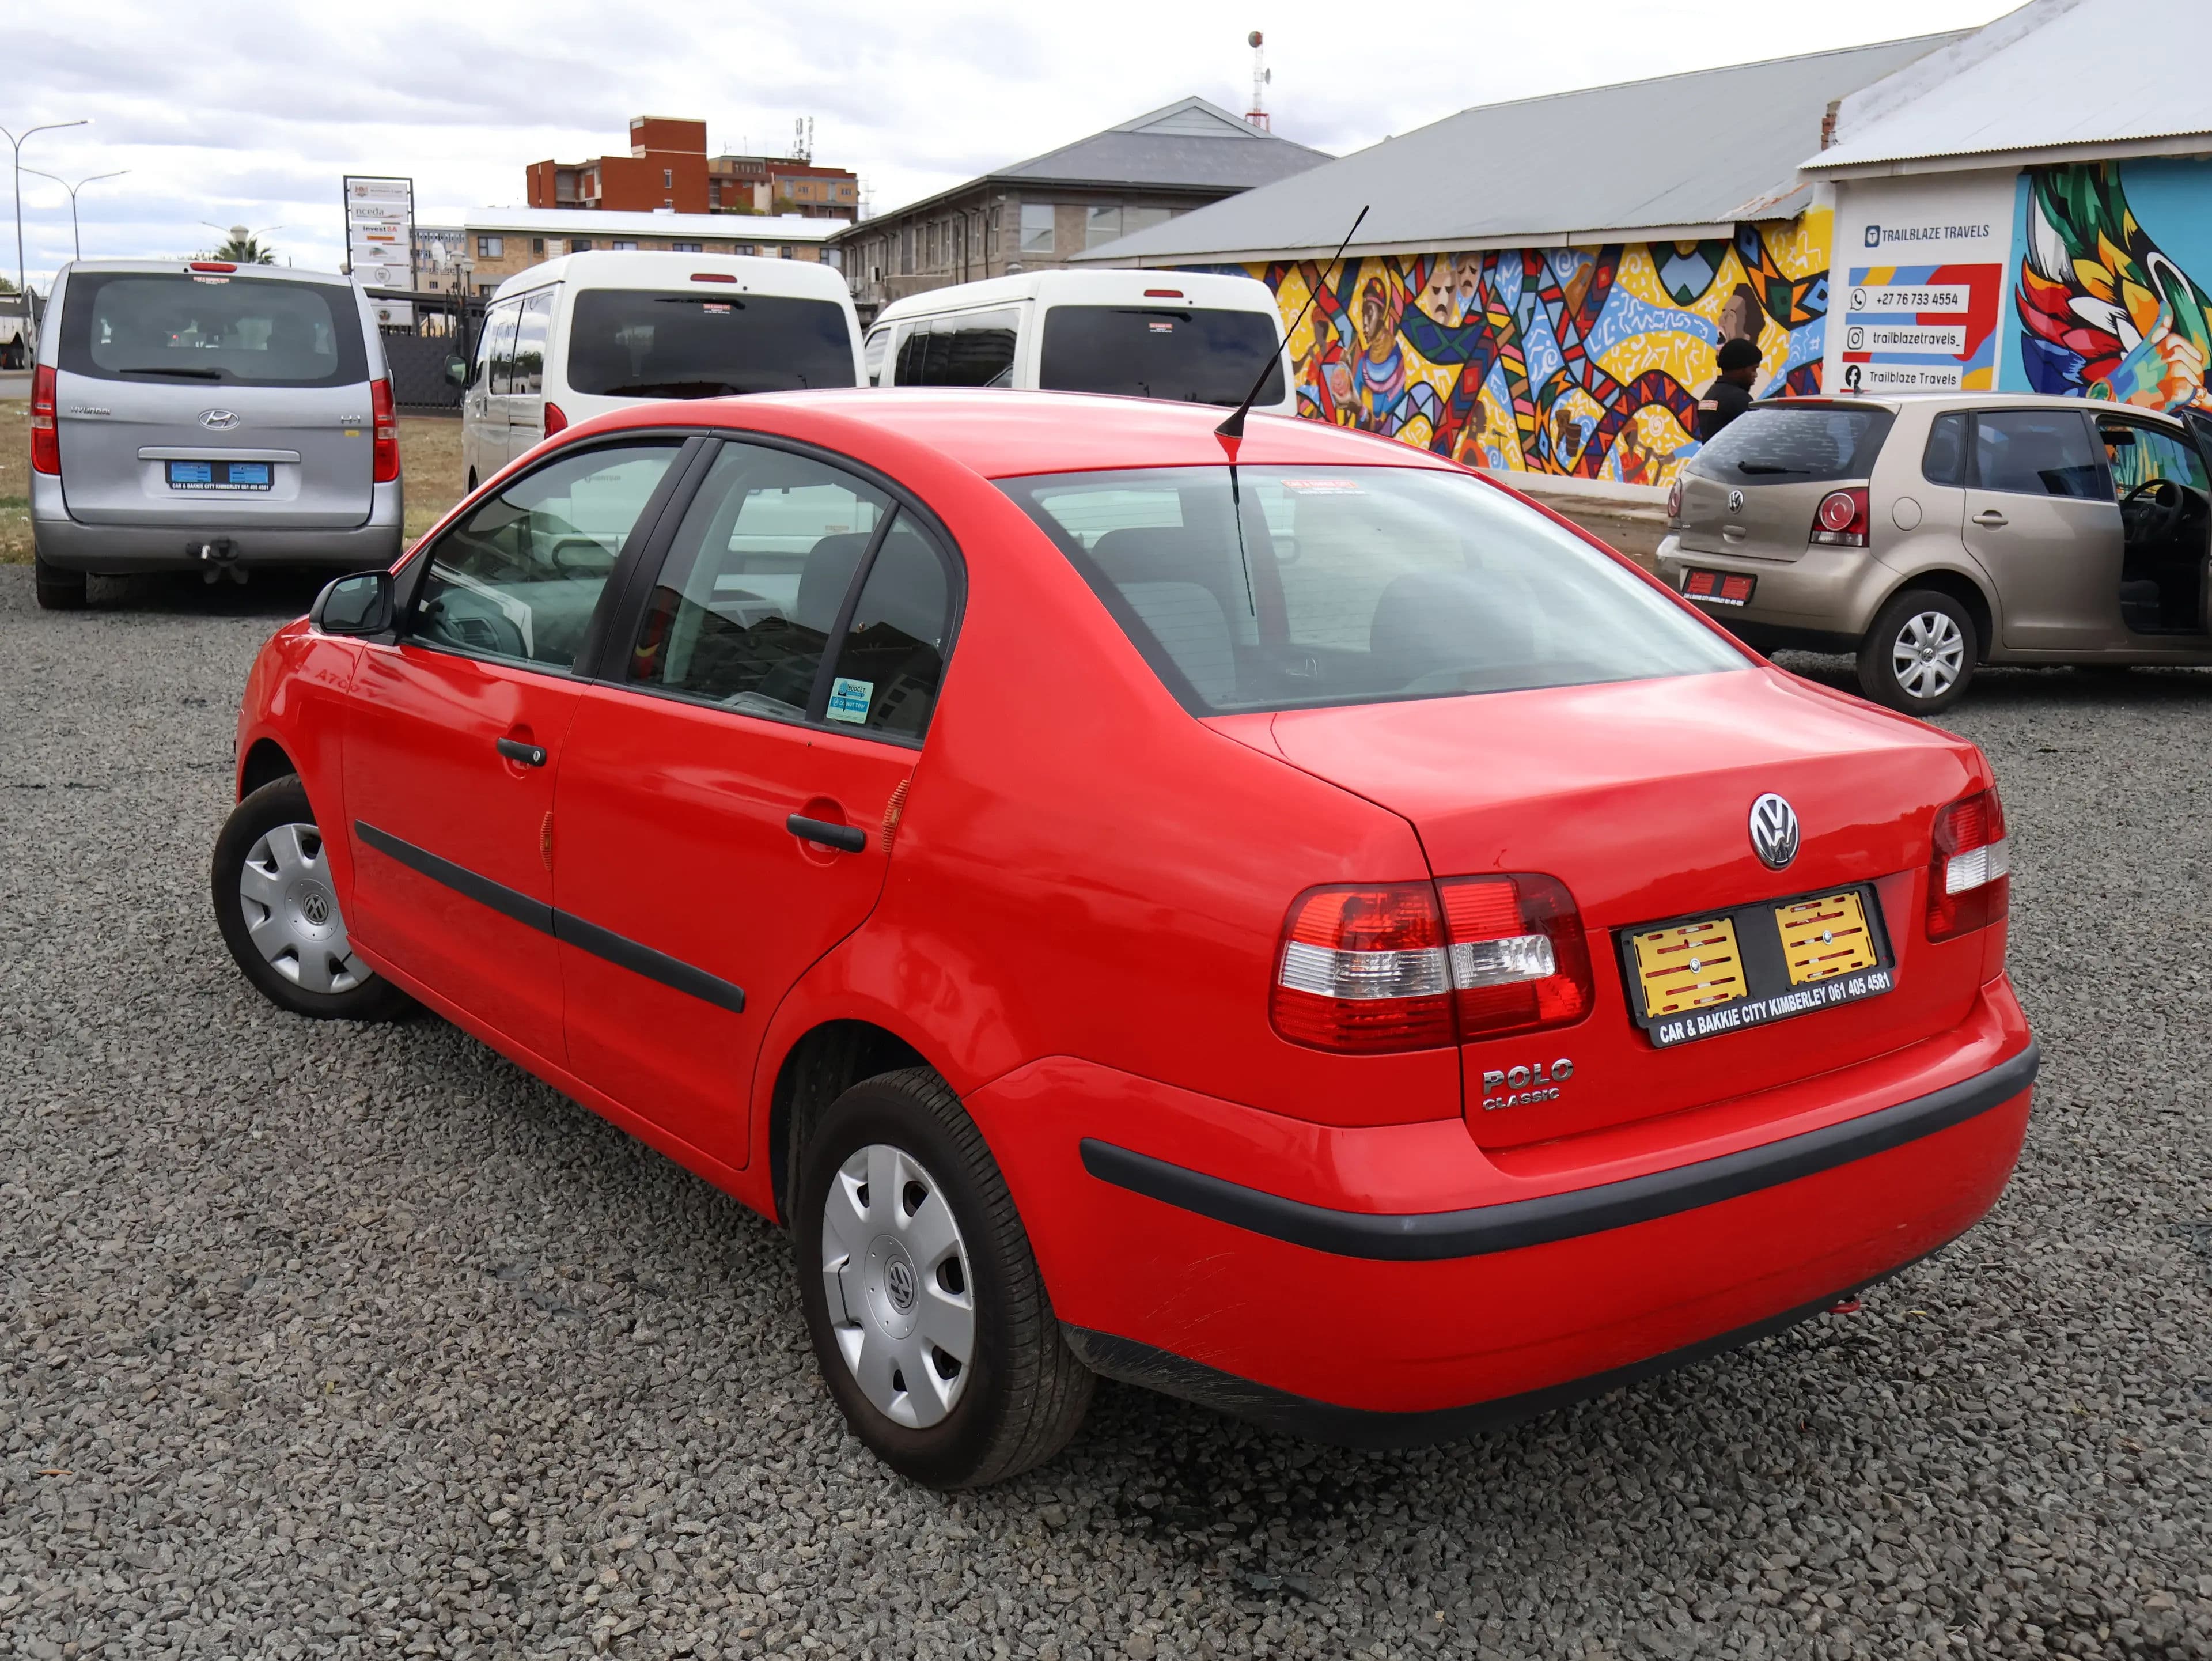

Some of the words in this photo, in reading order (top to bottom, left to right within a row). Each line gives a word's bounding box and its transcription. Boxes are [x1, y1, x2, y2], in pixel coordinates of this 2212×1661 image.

[356, 207, 384, 215] nceda
[1882, 227, 1941, 242] TRAILBLAZE
[1944, 225, 1990, 239] TRAVELS
[1877, 294, 1895, 305] +27
[1896, 294, 1908, 305] 76
[1911, 293, 1929, 305] 733
[1932, 293, 1958, 305] 4554
[1873, 332, 1960, 346] trailblazetravels_
[1870, 371, 1916, 384] Trailblaze
[1919, 373, 1956, 385] Travels
[341, 415, 361, 425] H-1
[1660, 1024, 1685, 1043] CAR
[1687, 1019, 1696, 1037] &
[1697, 1009, 1741, 1035] BAKKIE
[1742, 1001, 1767, 1023] CITY
[1769, 986, 1827, 1016] KIMBERLEY
[1828, 983, 1847, 1001] 061
[1848, 978, 1866, 997] 405
[1868, 971, 1891, 992] 4581
[1483, 1058, 1574, 1095] POLO
[1482, 1087, 1560, 1111] CLASSIC
